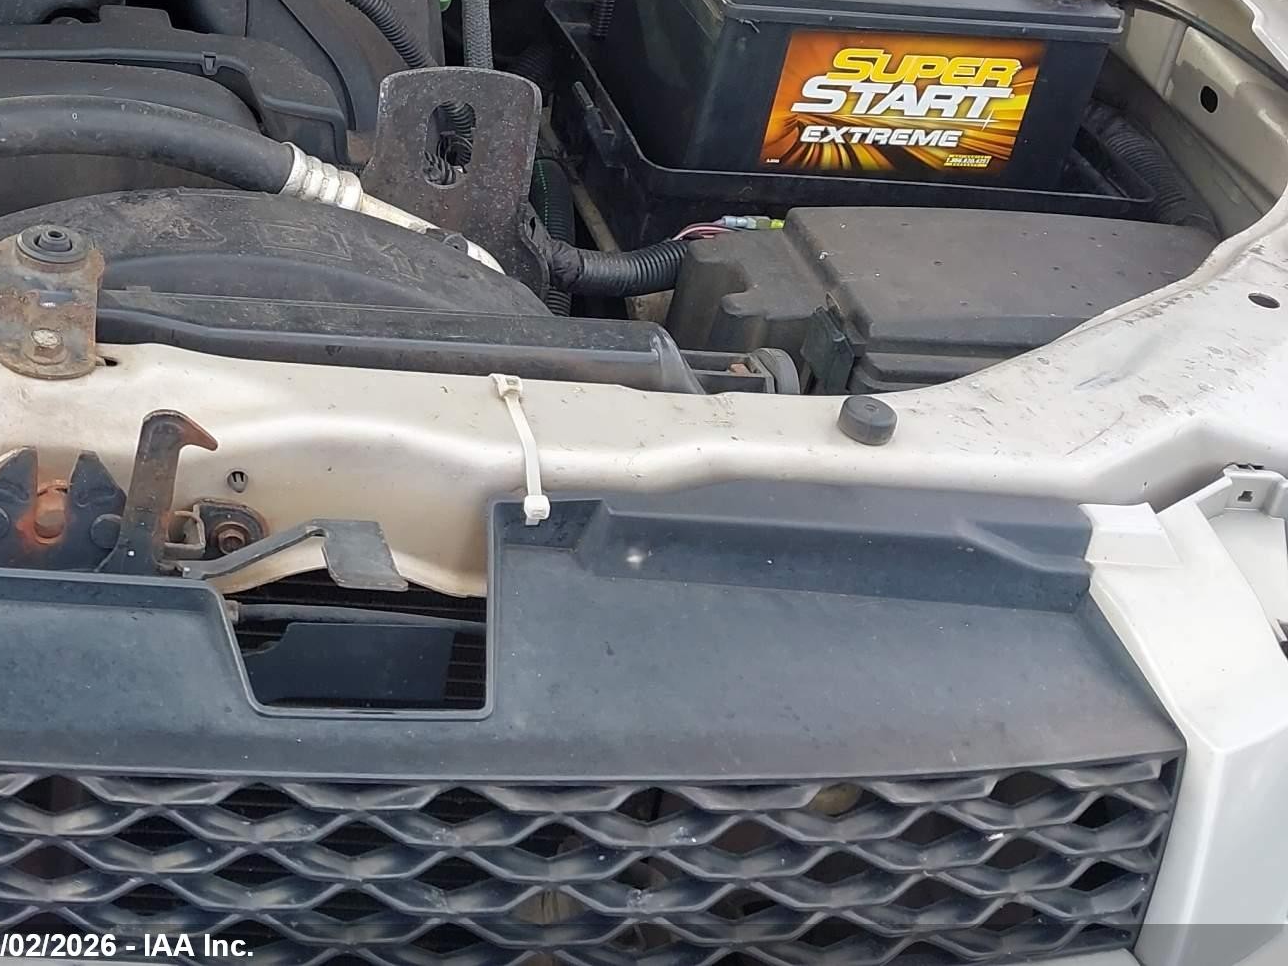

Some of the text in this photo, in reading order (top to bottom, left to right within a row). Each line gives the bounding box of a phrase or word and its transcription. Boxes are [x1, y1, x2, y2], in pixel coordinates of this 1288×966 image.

[827, 48, 1021, 87] SUPER
[791, 76, 1013, 118] START
[800, 125, 963, 147] EXTREME
